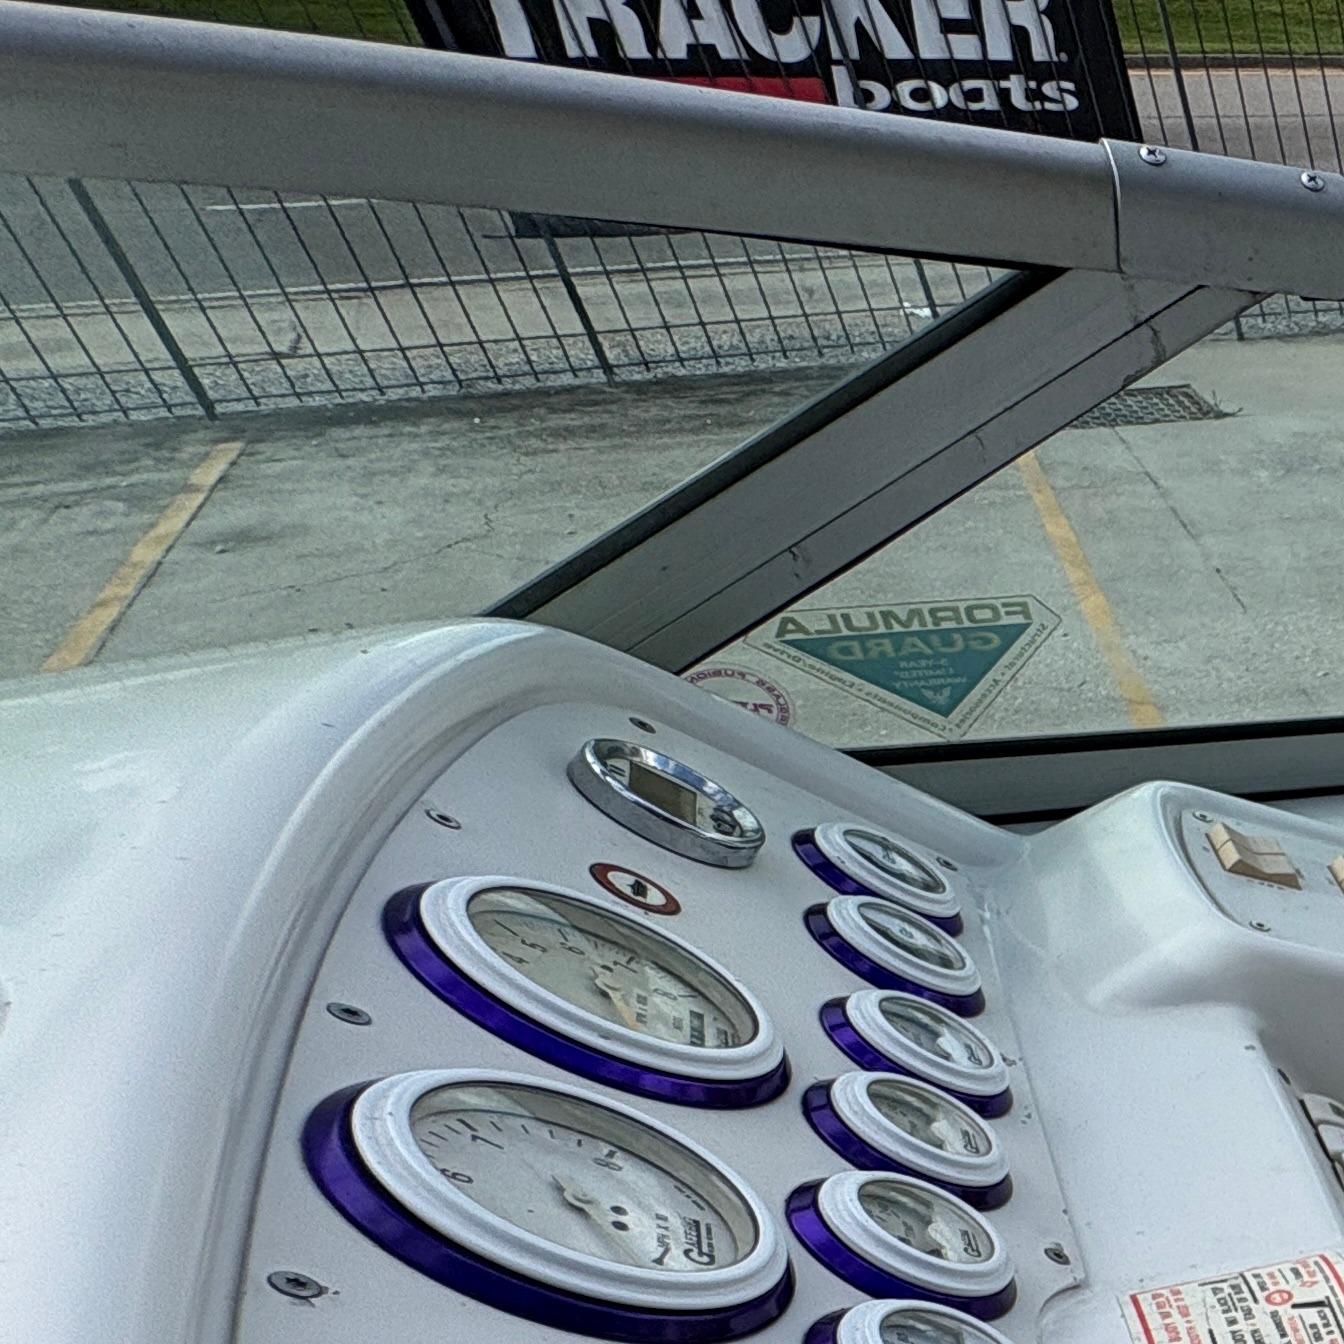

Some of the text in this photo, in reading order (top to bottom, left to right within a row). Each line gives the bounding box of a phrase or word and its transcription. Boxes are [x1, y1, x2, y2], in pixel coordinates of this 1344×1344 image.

[832, 65, 1080, 111] boats
[470, 1133, 504, 1150] 7
[592, 1156, 623, 1172] 8
[441, 1167, 475, 1184] 6
